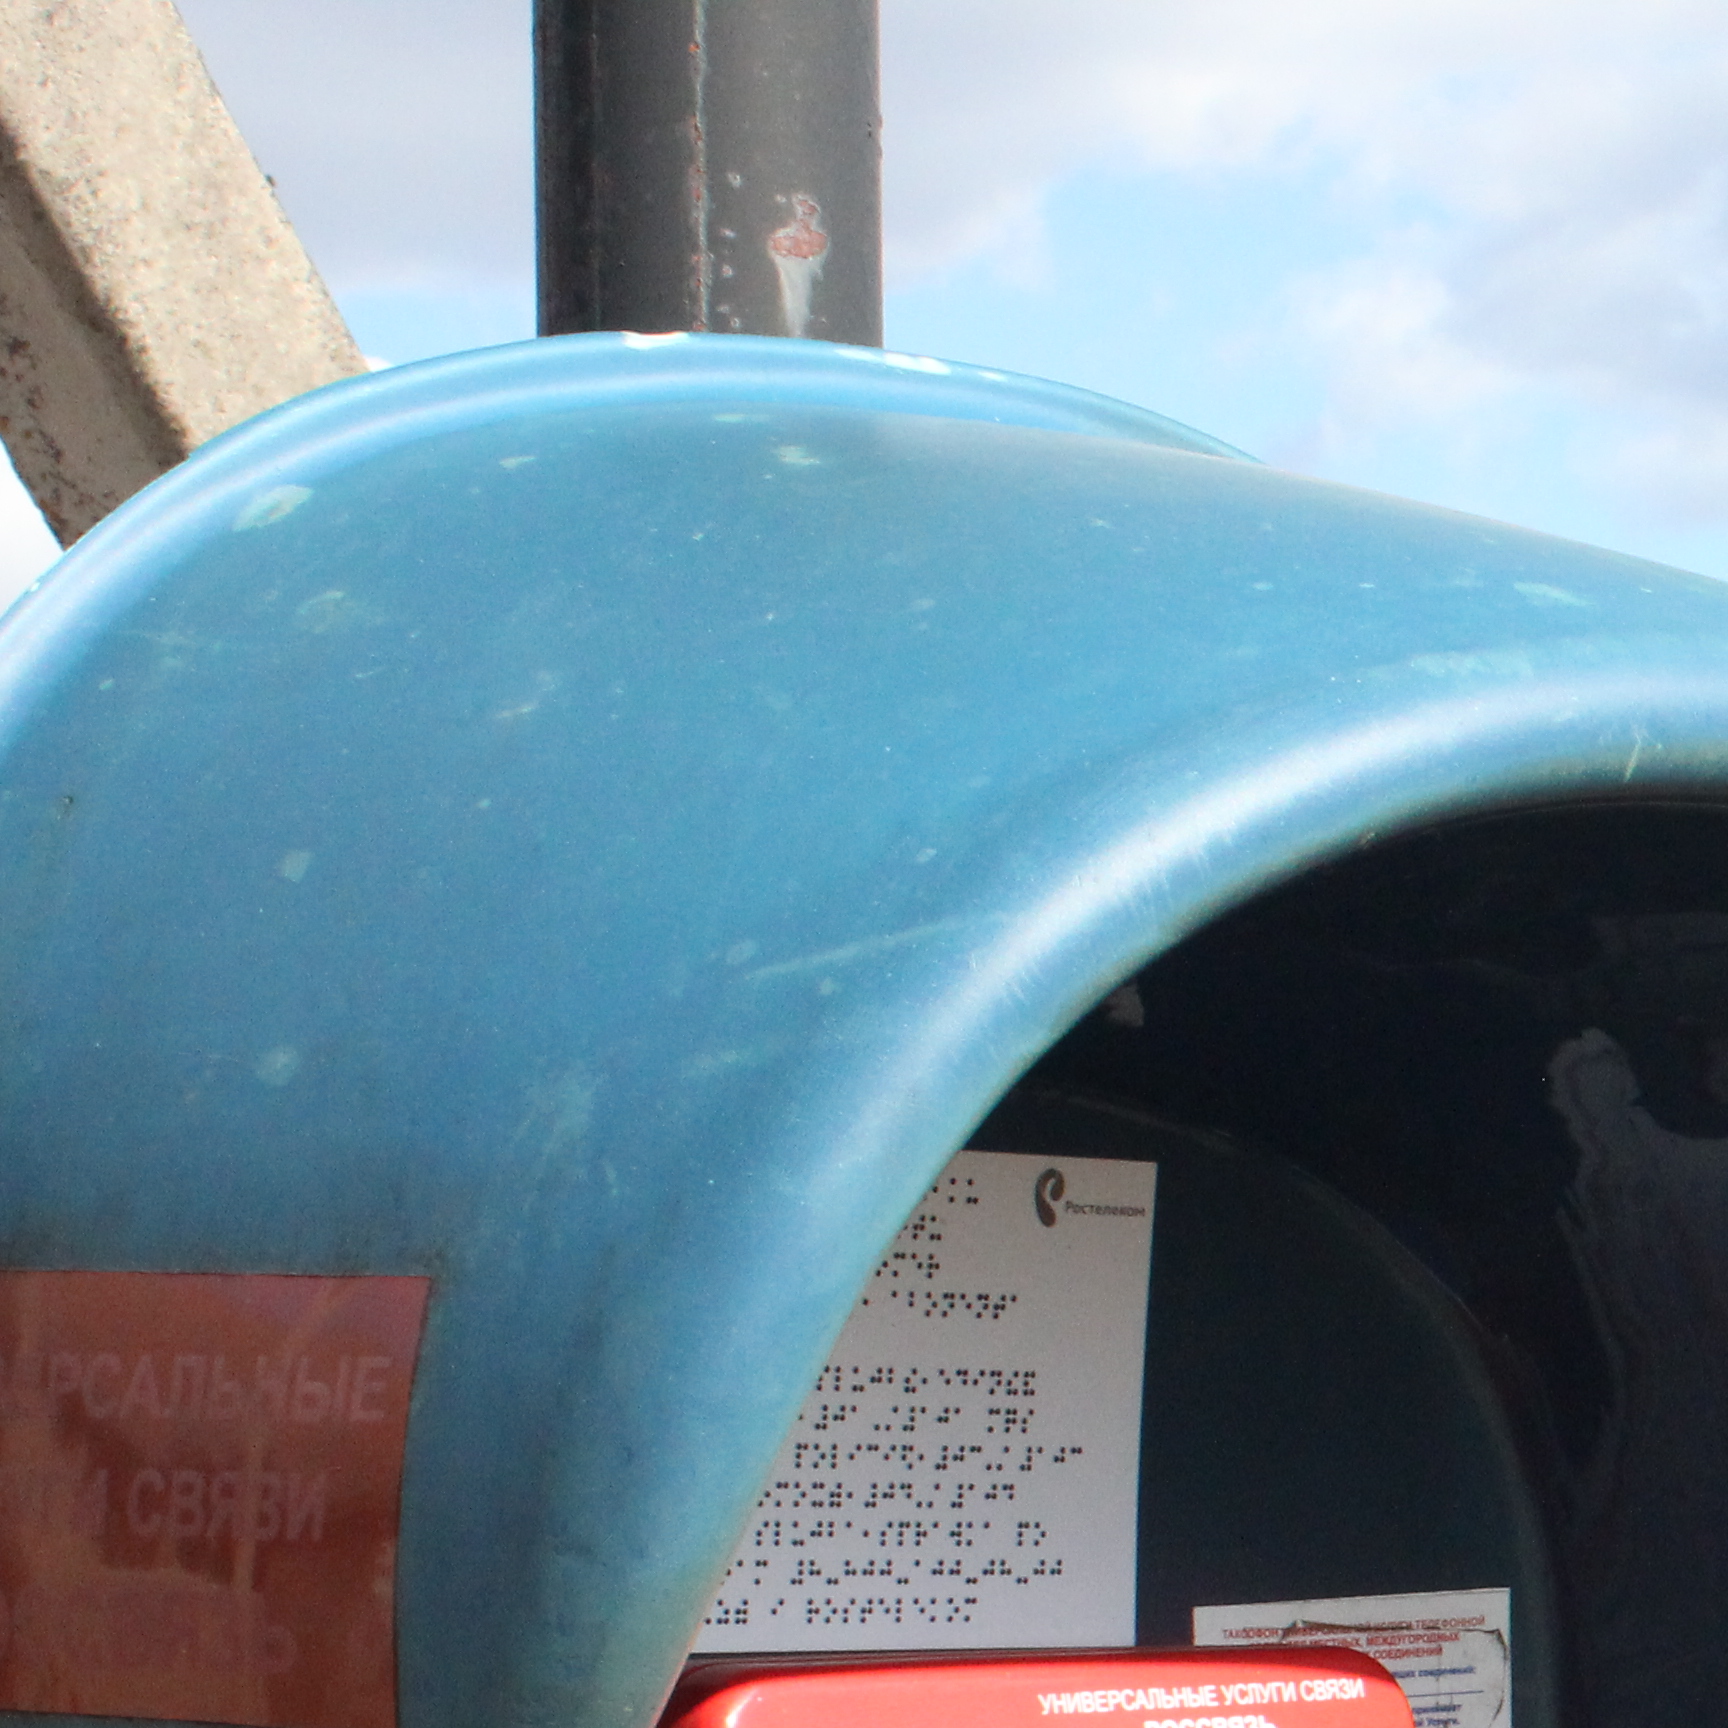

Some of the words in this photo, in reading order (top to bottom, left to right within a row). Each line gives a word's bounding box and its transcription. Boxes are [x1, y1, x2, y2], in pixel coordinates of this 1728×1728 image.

[1066, 1200, 1145, 1217] Ростелеком
[126, 1467, 329, 1543] СВЯЗИ
[1037, 1684, 1218, 1715] УНИВЕРСАЛЬНЫЕ
[1220, 1680, 1297, 1706] УСЛУГИ
[1299, 1677, 1365, 1701] СВЯЗИ
